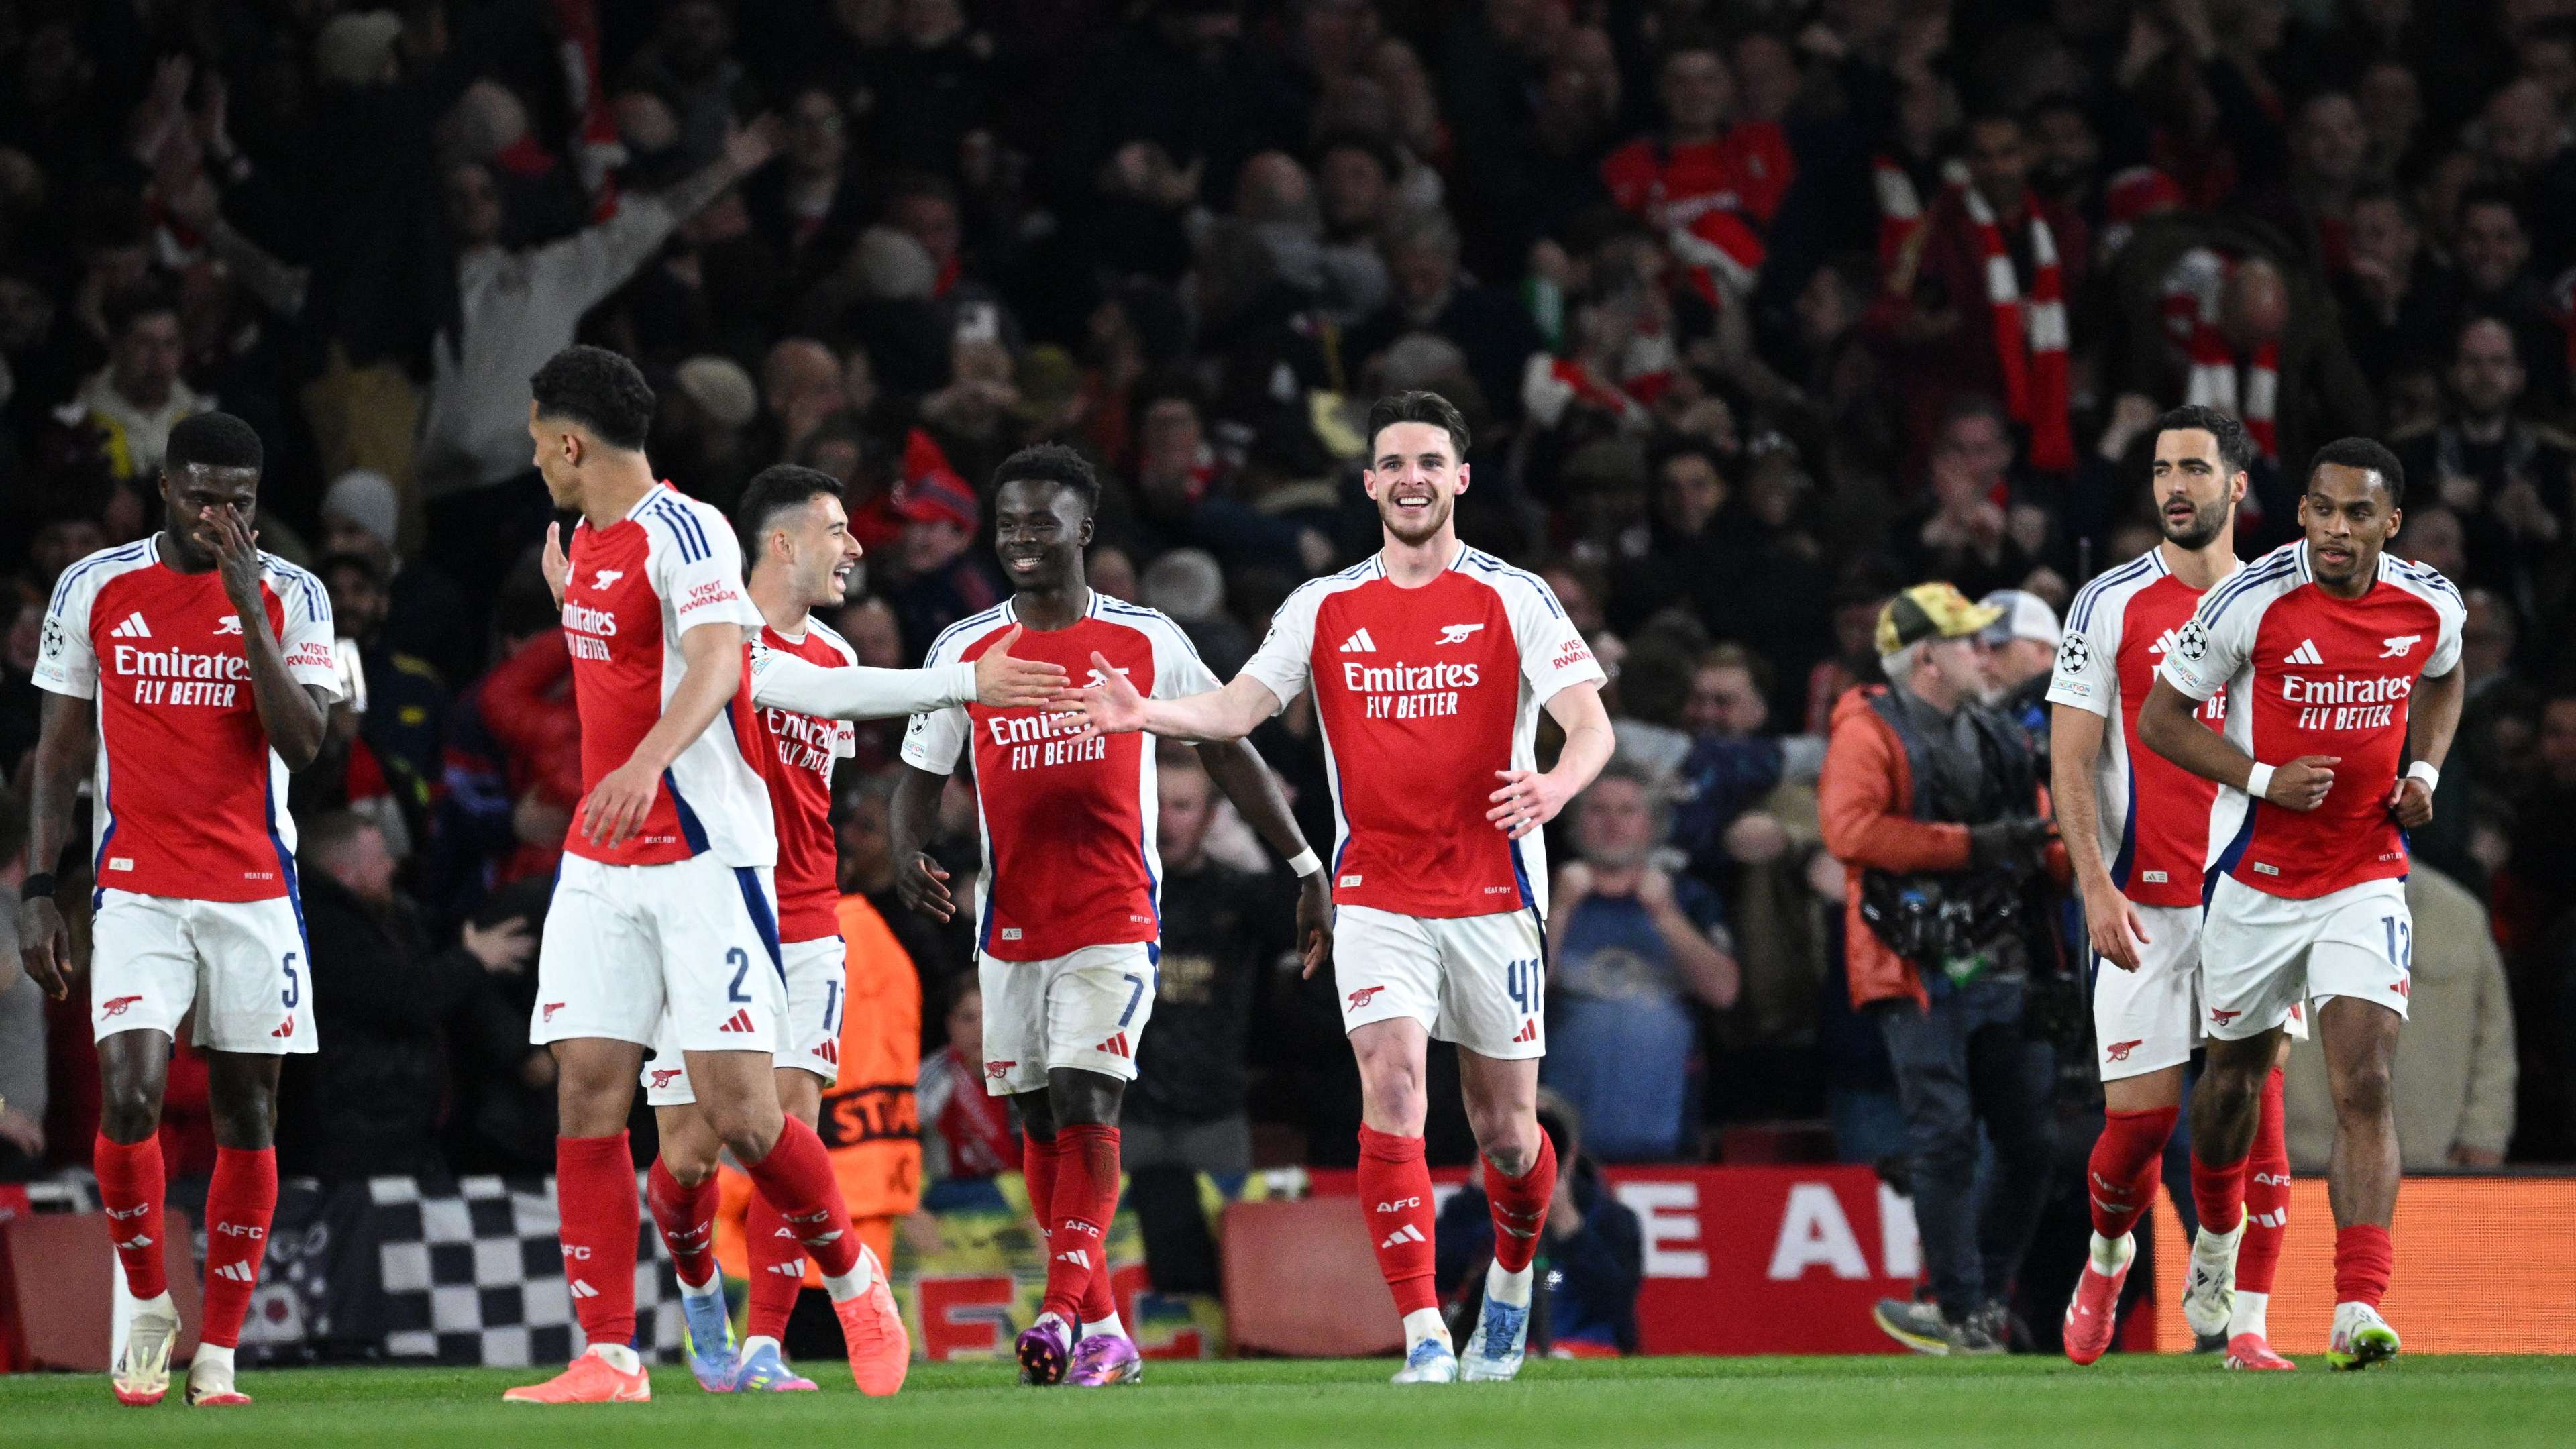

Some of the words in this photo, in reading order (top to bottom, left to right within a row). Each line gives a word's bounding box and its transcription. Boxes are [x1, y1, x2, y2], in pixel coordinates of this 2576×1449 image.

[679, 590, 739, 615] RWANDA
[688, 580, 722, 598] VISIT
[300, 642, 328, 655] VISIT
[1342, 661, 1479, 692] Emirates
[2283, 674, 2412, 704] Emirates
[134, 680, 166, 704] FLY
[169, 681, 236, 708] BETTER
[1366, 696, 1392, 719] FLY
[1396, 692, 1459, 719] BETTER
[2298, 706, 2332, 731] FLY
[2334, 704, 2394, 731] BETTER
[779, 740, 802, 765] FLY
[1012, 744, 1039, 770] FLY
[1044, 736, 1106, 766] BETTER
[2381, 916, 2411, 970] 12
[282, 953, 299, 1008] 5
[727, 947, 752, 1003] 2
[1507, 958, 1539, 1014] 41
[1118, 973, 1144, 1028] 7
[2254, 1172, 2290, 1187] AFC
[1377, 1196, 1421, 1213] AFC
[217, 1221, 263, 1239] AFC
[1065, 1220, 1100, 1238] AFC
